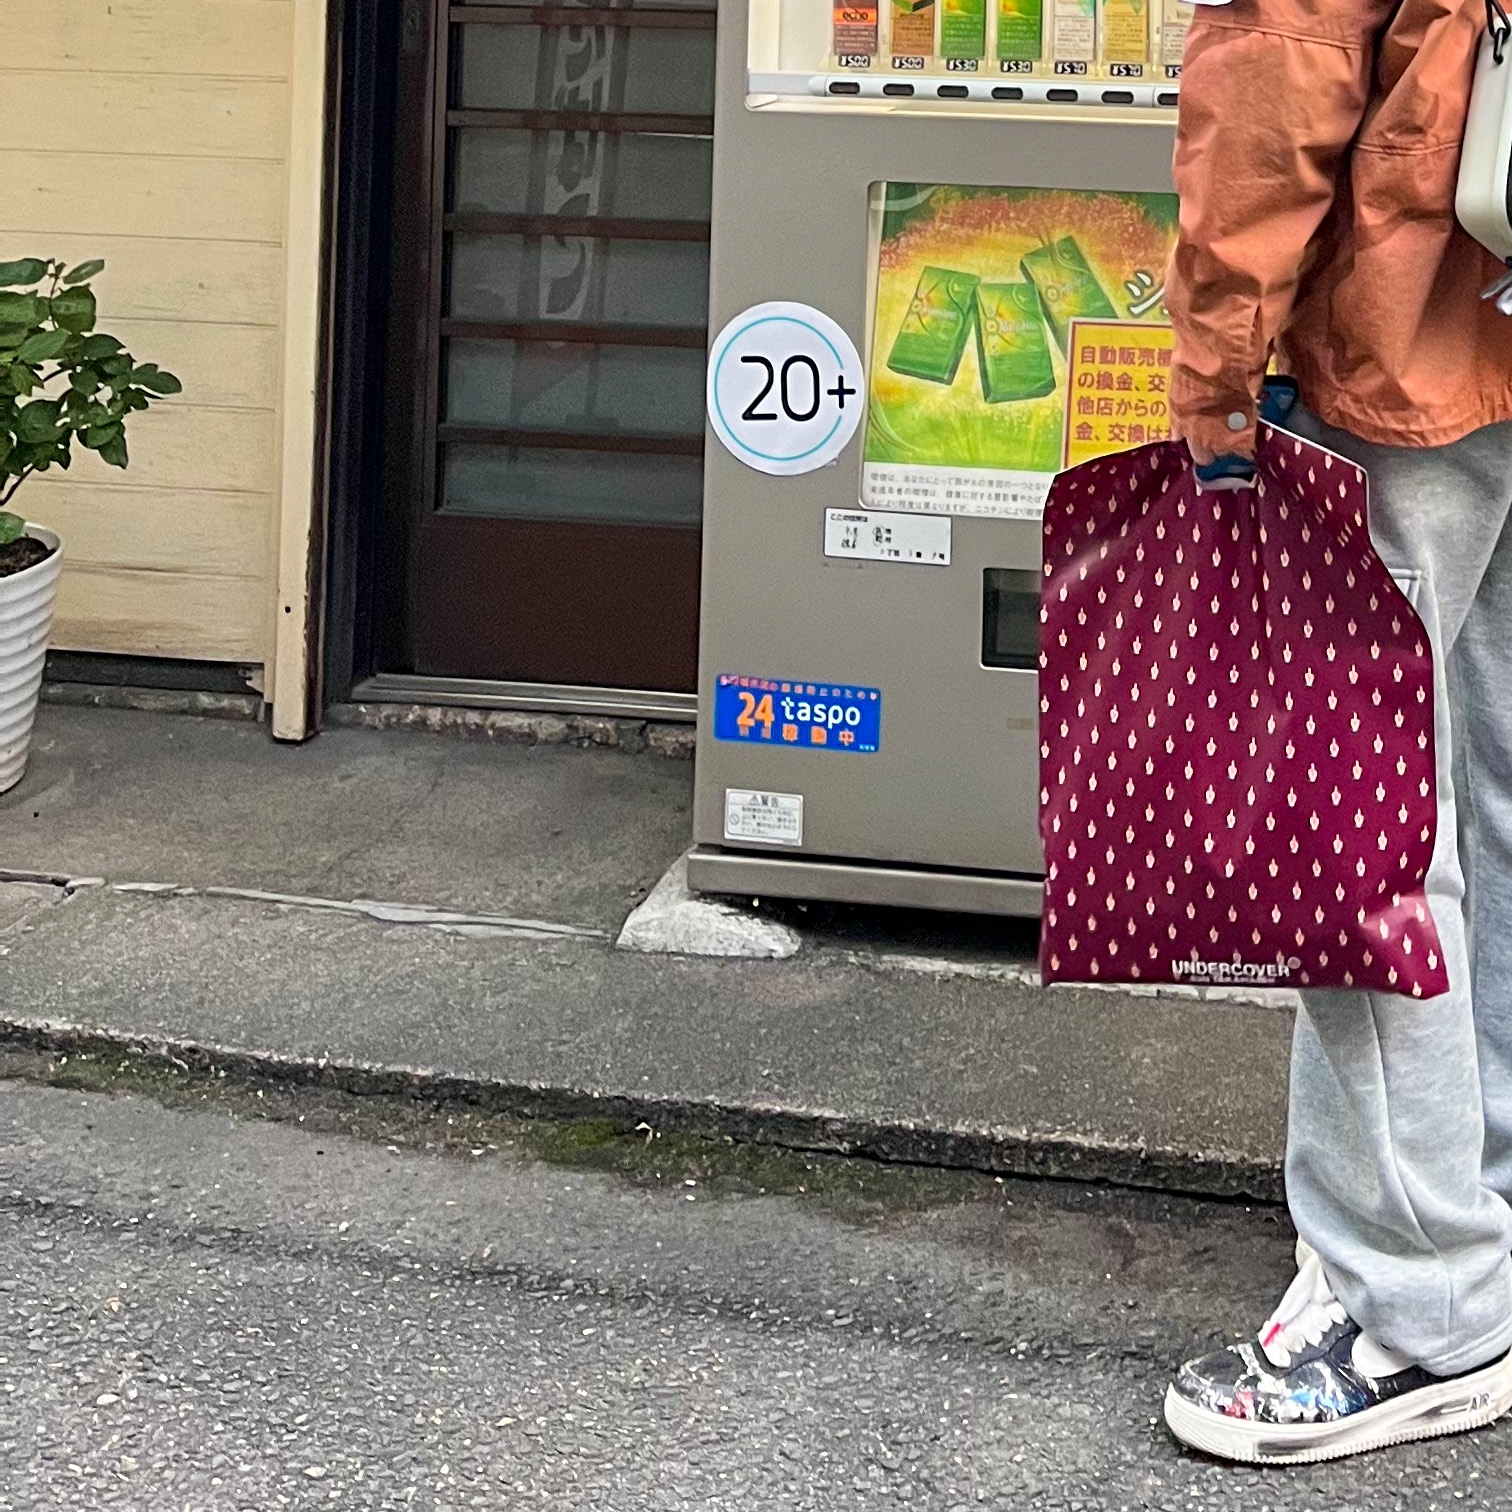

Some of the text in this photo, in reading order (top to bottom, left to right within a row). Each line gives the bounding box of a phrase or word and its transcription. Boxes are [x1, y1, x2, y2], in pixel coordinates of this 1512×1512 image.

[740, 354, 857, 422] 20+
[780, 696, 861, 730] taspo
[1171, 959, 1290, 978] UNDERCOVER
